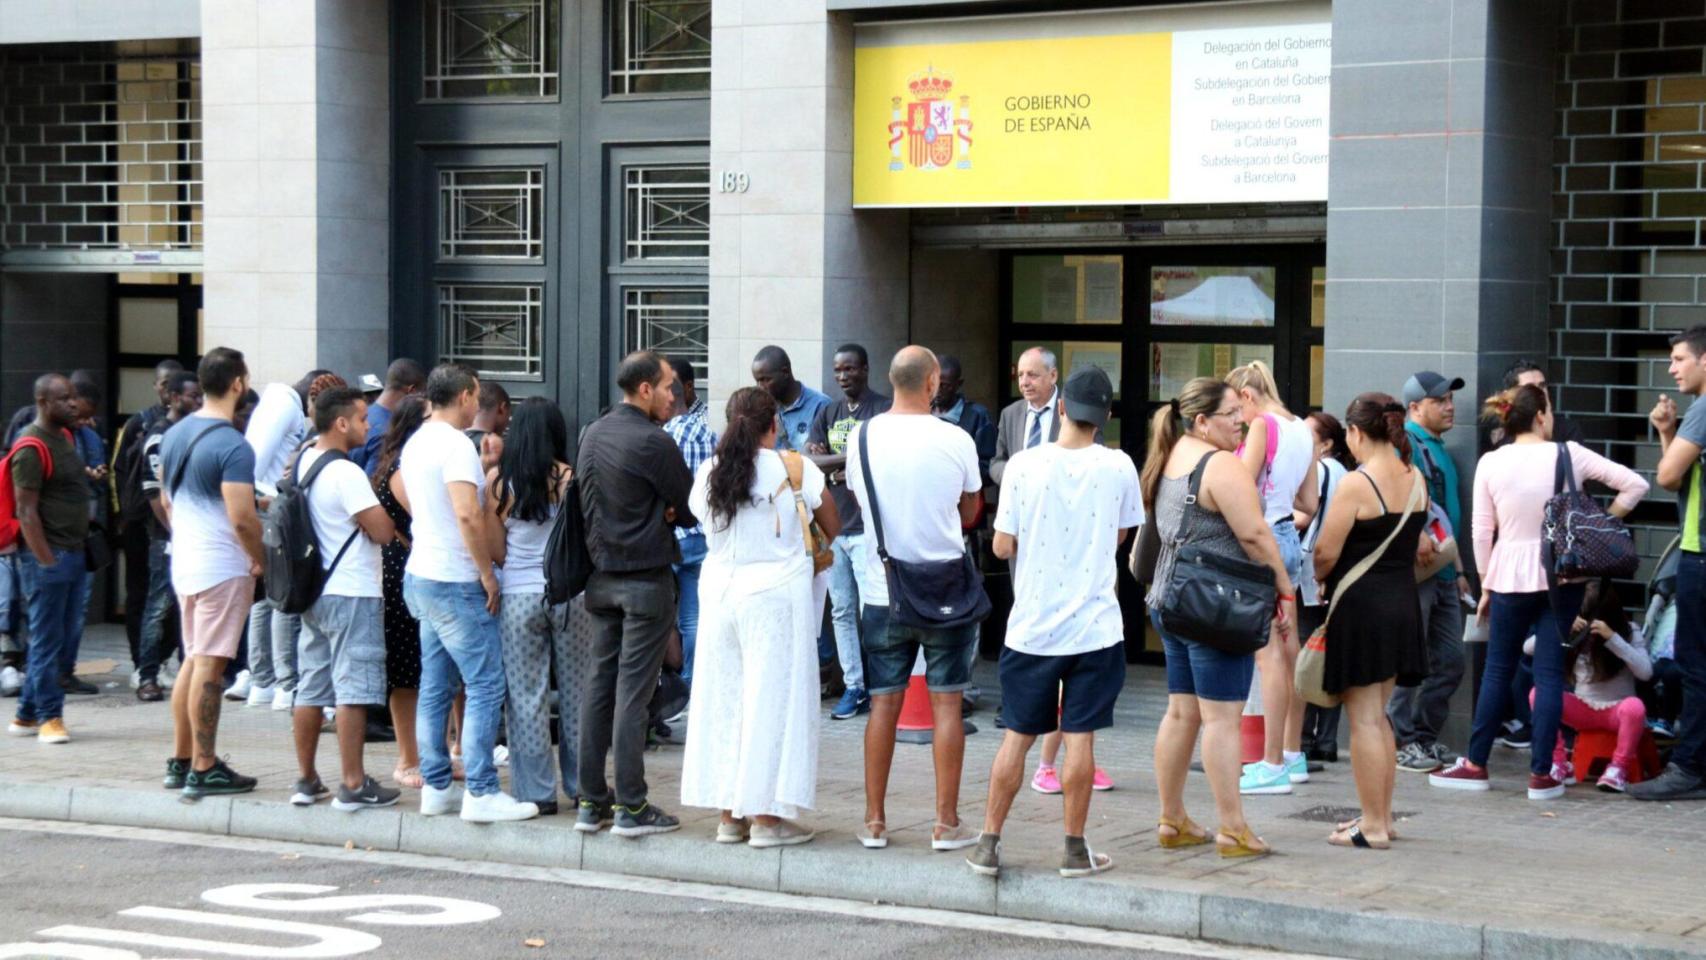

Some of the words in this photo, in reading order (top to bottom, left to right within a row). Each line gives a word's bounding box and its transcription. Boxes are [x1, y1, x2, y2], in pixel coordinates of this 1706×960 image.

[1203, 41, 1262, 56] Delegación
[1264, 38, 1280, 51] del
[1283, 36, 1332, 50] Gobierno
[1235, 60, 1248, 70] en
[1251, 56, 1299, 70] Cataluña
[1194, 76, 1270, 92] Subdelegación
[1273, 75, 1289, 87] del
[1292, 73, 1331, 87] Gobier
[1004, 93, 1091, 112] GOBIERNO
[1232, 95, 1245, 106] en
[1248, 92, 1301, 106] Barcelona
[1004, 118, 1025, 133] DE
[1030, 112, 1092, 132] ESPAÑA
[1210, 118, 1262, 133] Delegació
[1265, 117, 1281, 129] del
[1283, 115, 1323, 129] Govern
[1234, 139, 1241, 148] a
[1244, 135, 1297, 151] Catalunya
[1200, 153, 1271, 168] Subdelegació
[1273, 152, 1289, 165] del
[719, 169, 751, 193] 189
[1234, 174, 1240, 184] a
[1243, 170, 1296, 184] Barcelona
